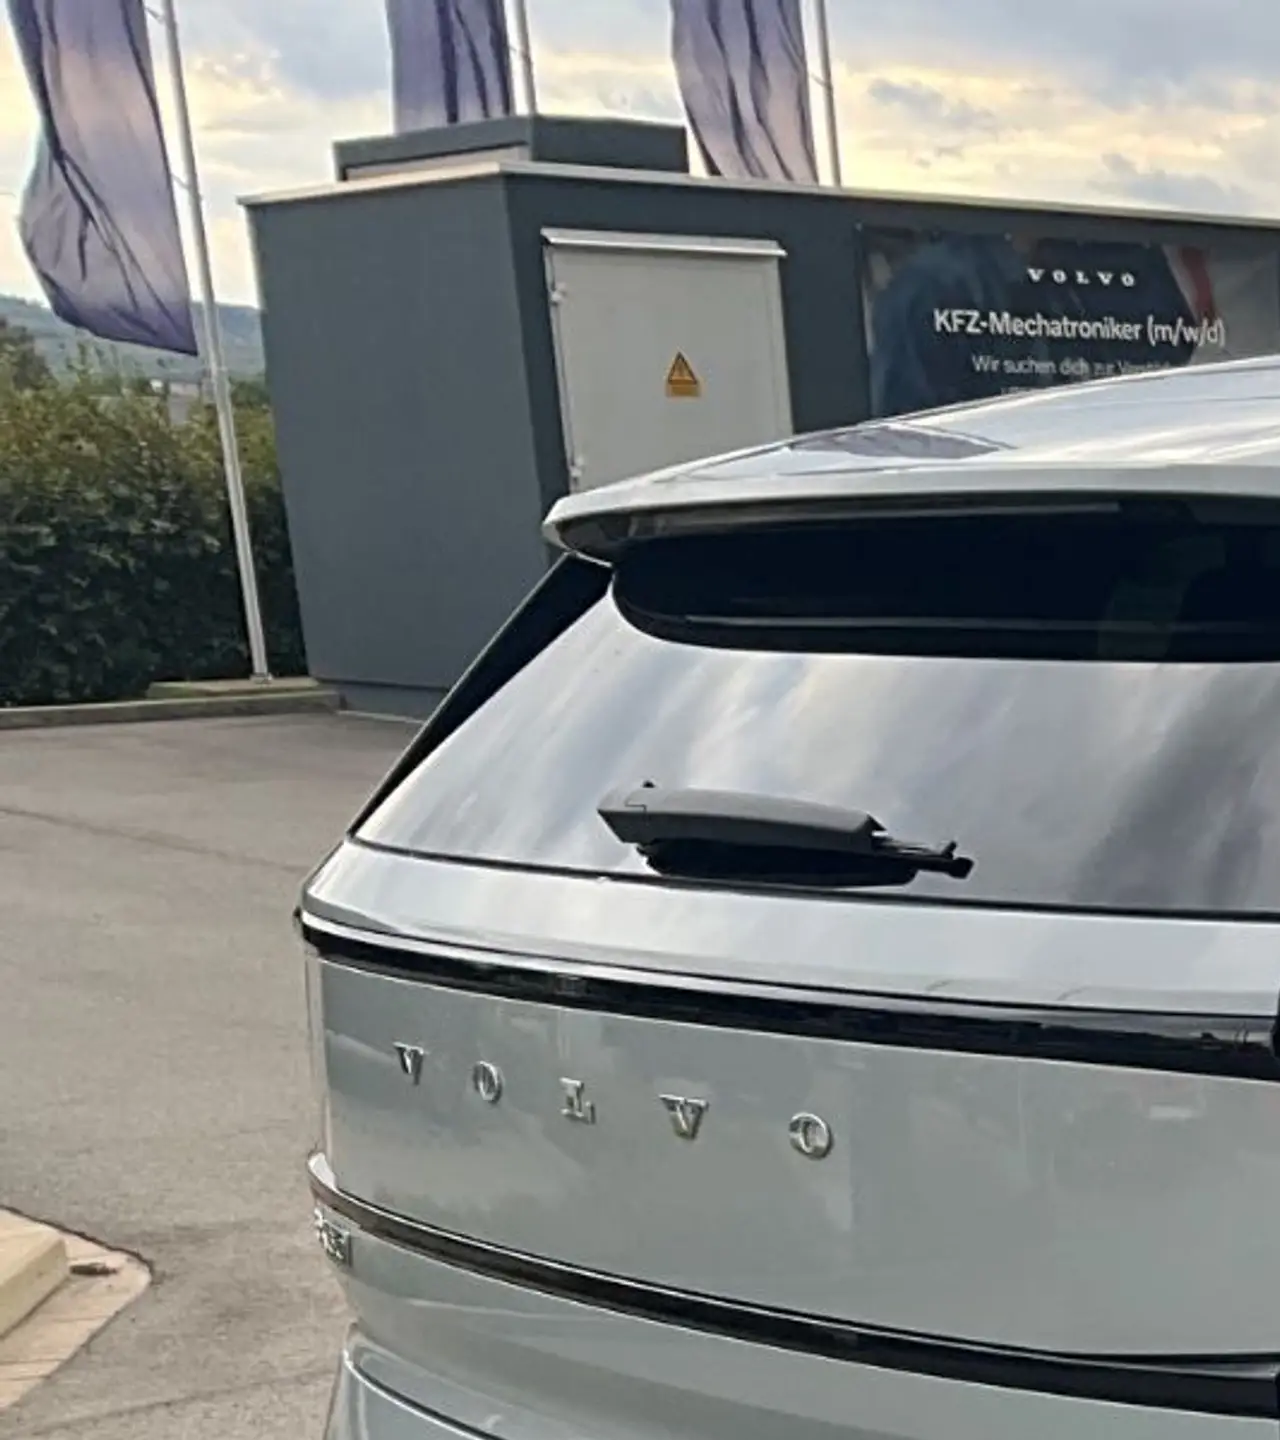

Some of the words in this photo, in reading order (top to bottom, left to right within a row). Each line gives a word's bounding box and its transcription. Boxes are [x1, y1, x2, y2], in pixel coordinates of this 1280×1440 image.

[1027, 267, 1136, 288] VOLVO
[933, 308, 1142, 341] KFZ-Mechatroniker
[1147, 315, 1225, 346] (m/w/d)
[971, 354, 999, 374] Wir
[1002, 356, 1055, 375] suchen
[392, 1041, 833, 1160] VOLVO
